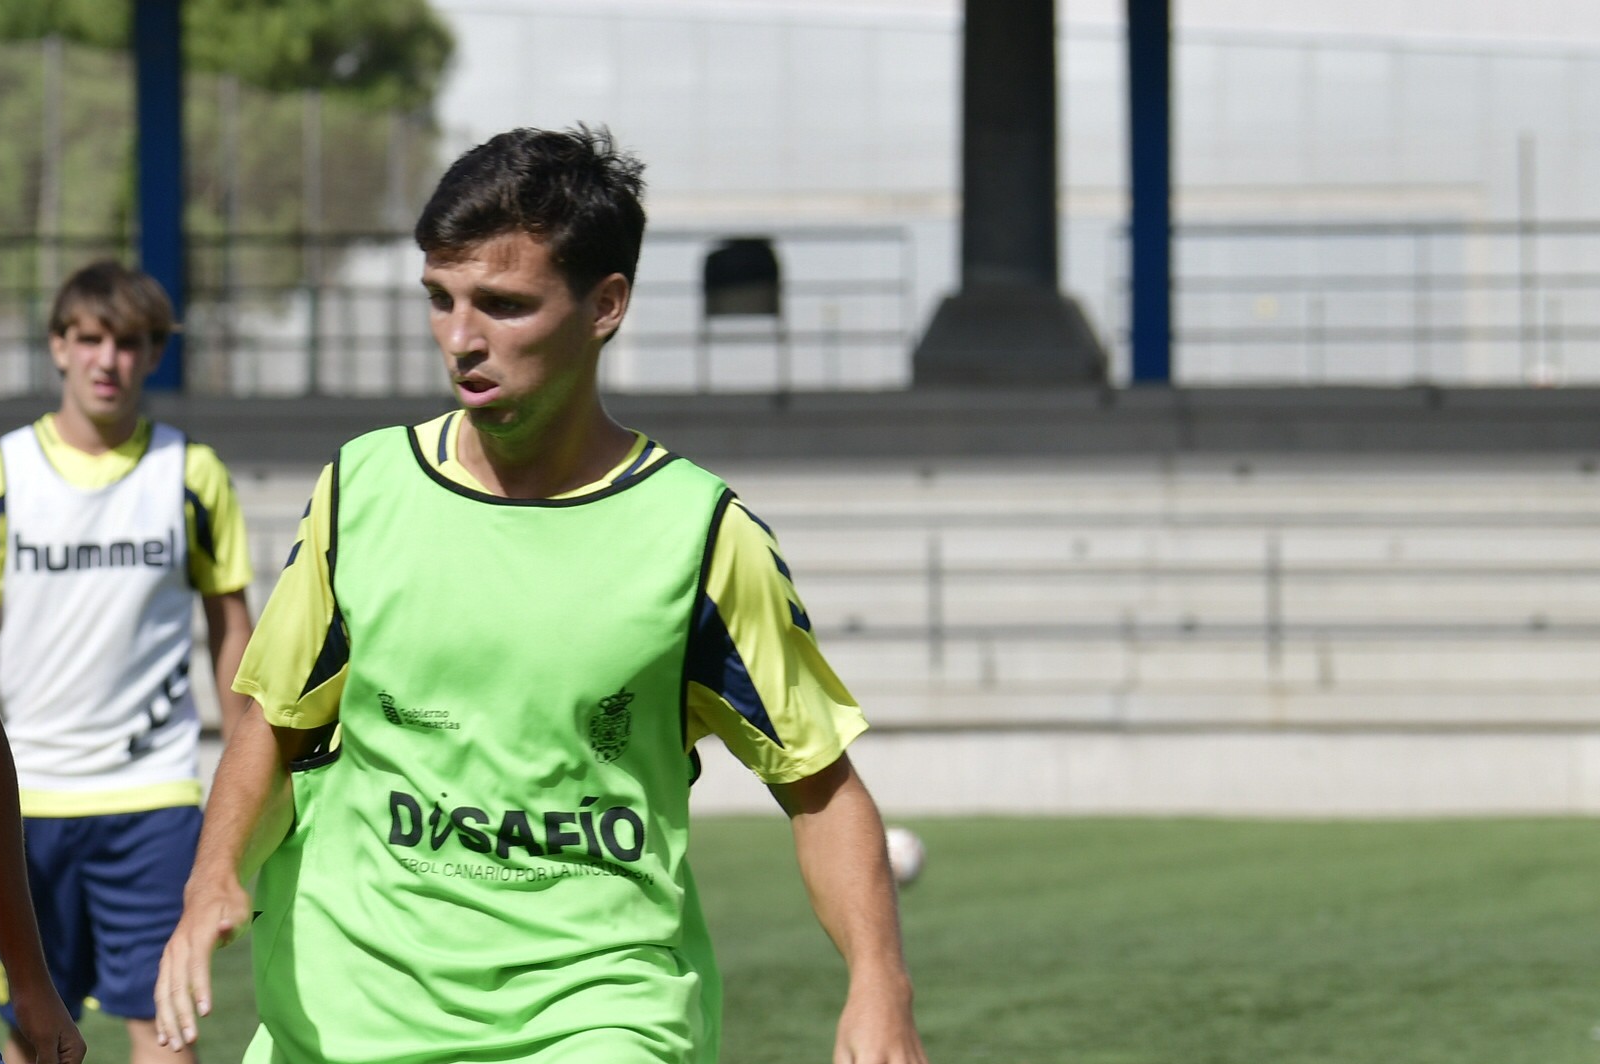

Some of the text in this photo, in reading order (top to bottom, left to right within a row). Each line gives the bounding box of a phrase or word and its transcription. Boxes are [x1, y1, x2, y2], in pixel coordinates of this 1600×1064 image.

[15, 528, 175, 573] hummel
[443, 862, 512, 882] CANARIO
[515, 867, 548, 882] POR
[550, 863, 572, 879] LA
